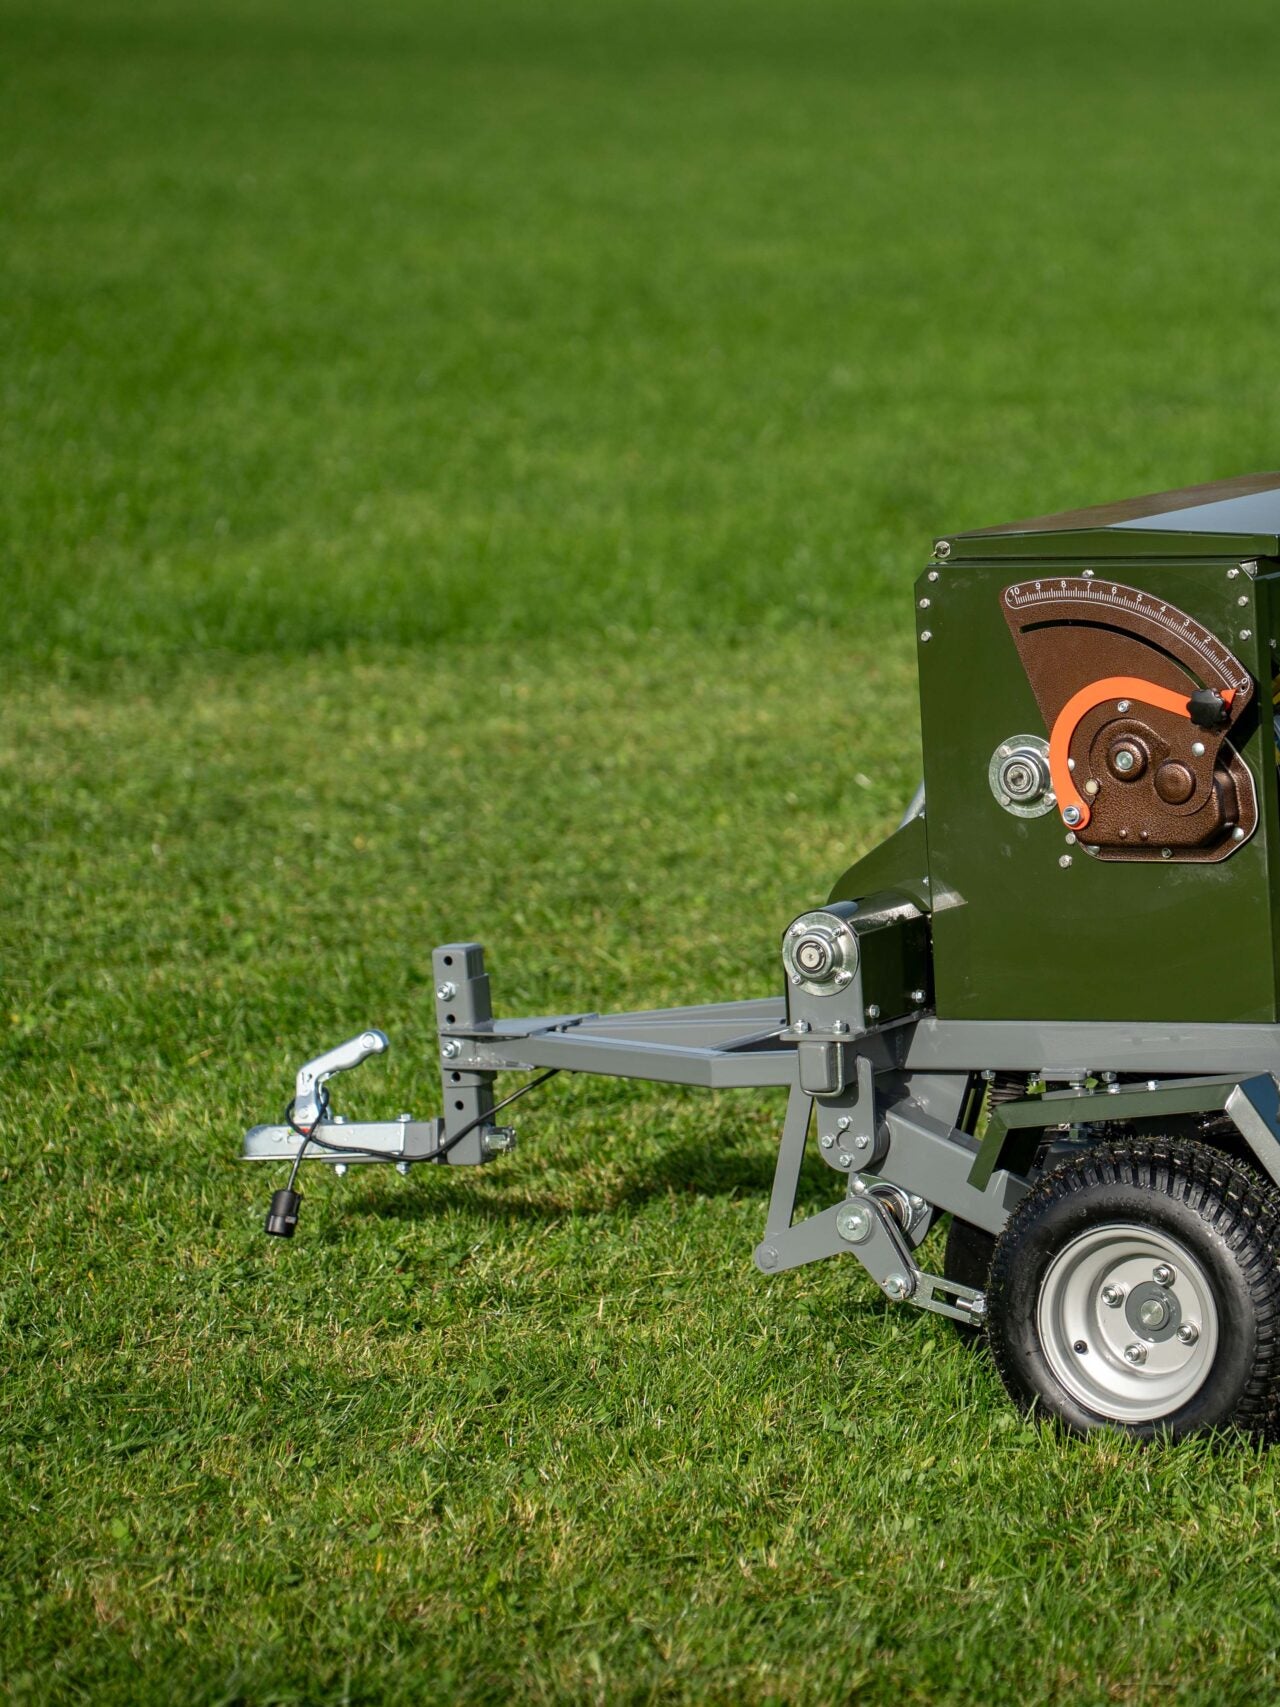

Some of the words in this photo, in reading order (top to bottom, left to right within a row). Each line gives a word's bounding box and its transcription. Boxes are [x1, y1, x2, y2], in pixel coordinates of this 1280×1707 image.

[1010, 587, 1020, 596] 10
[1035, 582, 1041, 590] 9
[1061, 580, 1067, 588] 8
[1086, 581, 1092, 589] 7
[1111, 586, 1117, 594] 6
[1136, 594, 1143, 602] 5
[1160, 605, 1166, 613] 4
[1184, 619, 1190, 627] 3
[1204, 636, 1212, 644] 2
[1224, 655, 1230, 663] 1
